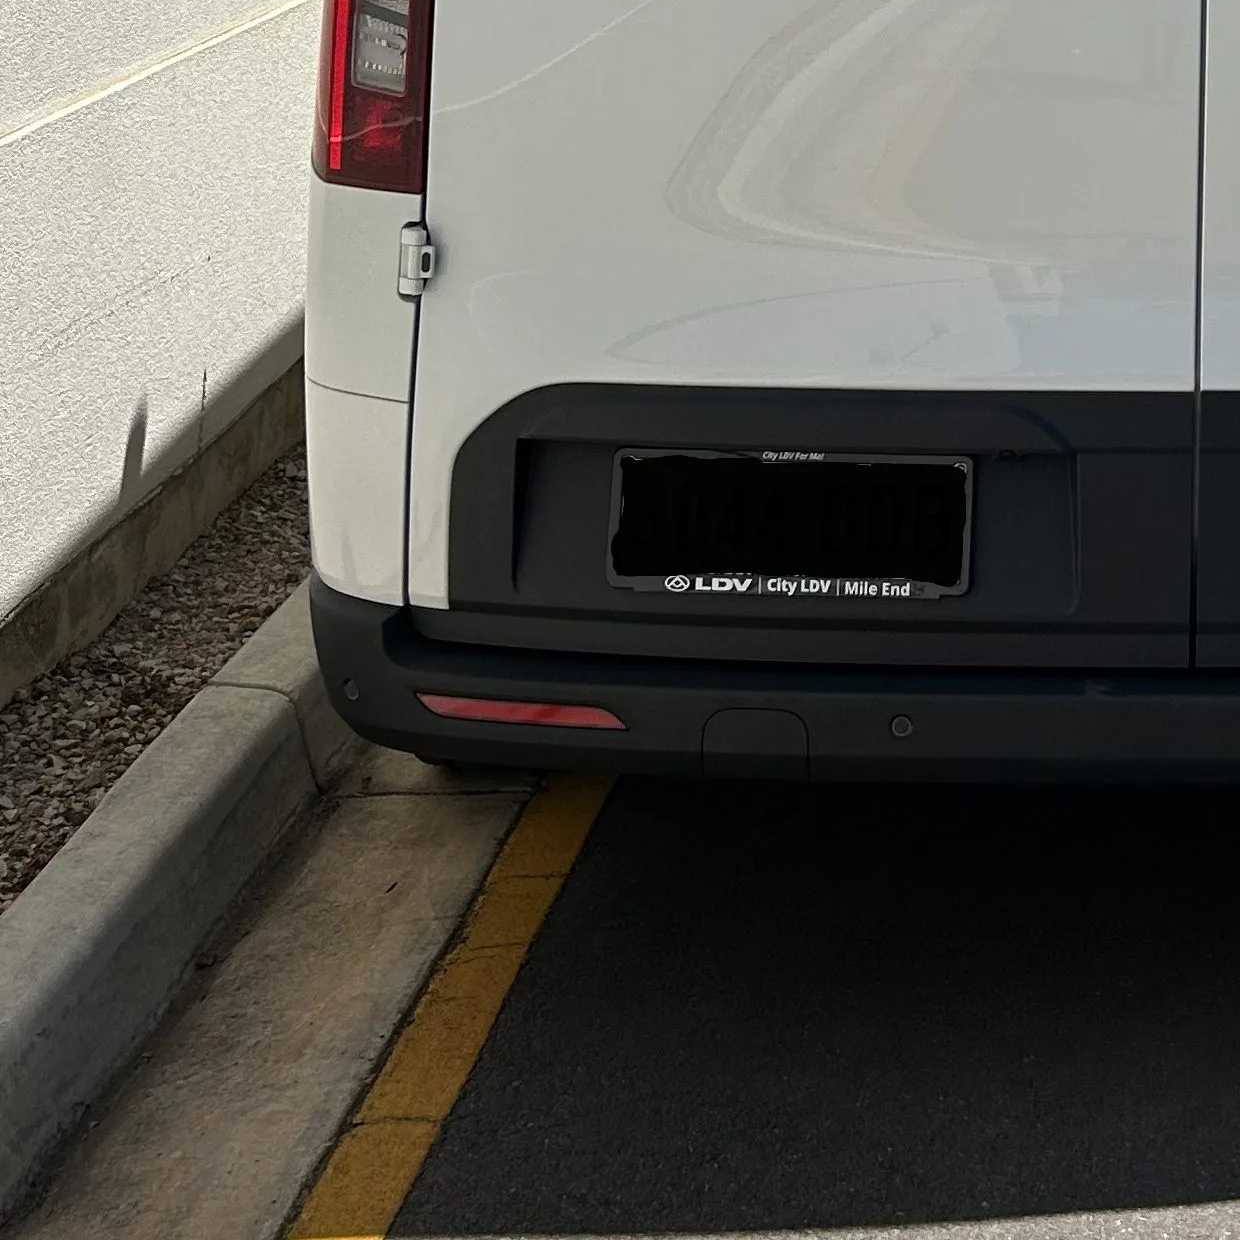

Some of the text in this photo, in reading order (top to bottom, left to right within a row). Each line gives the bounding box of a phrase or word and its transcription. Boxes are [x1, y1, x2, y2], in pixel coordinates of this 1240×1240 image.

[762, 451, 778, 461] City
[695, 577, 911, 597] LDV City LDV Mile End
